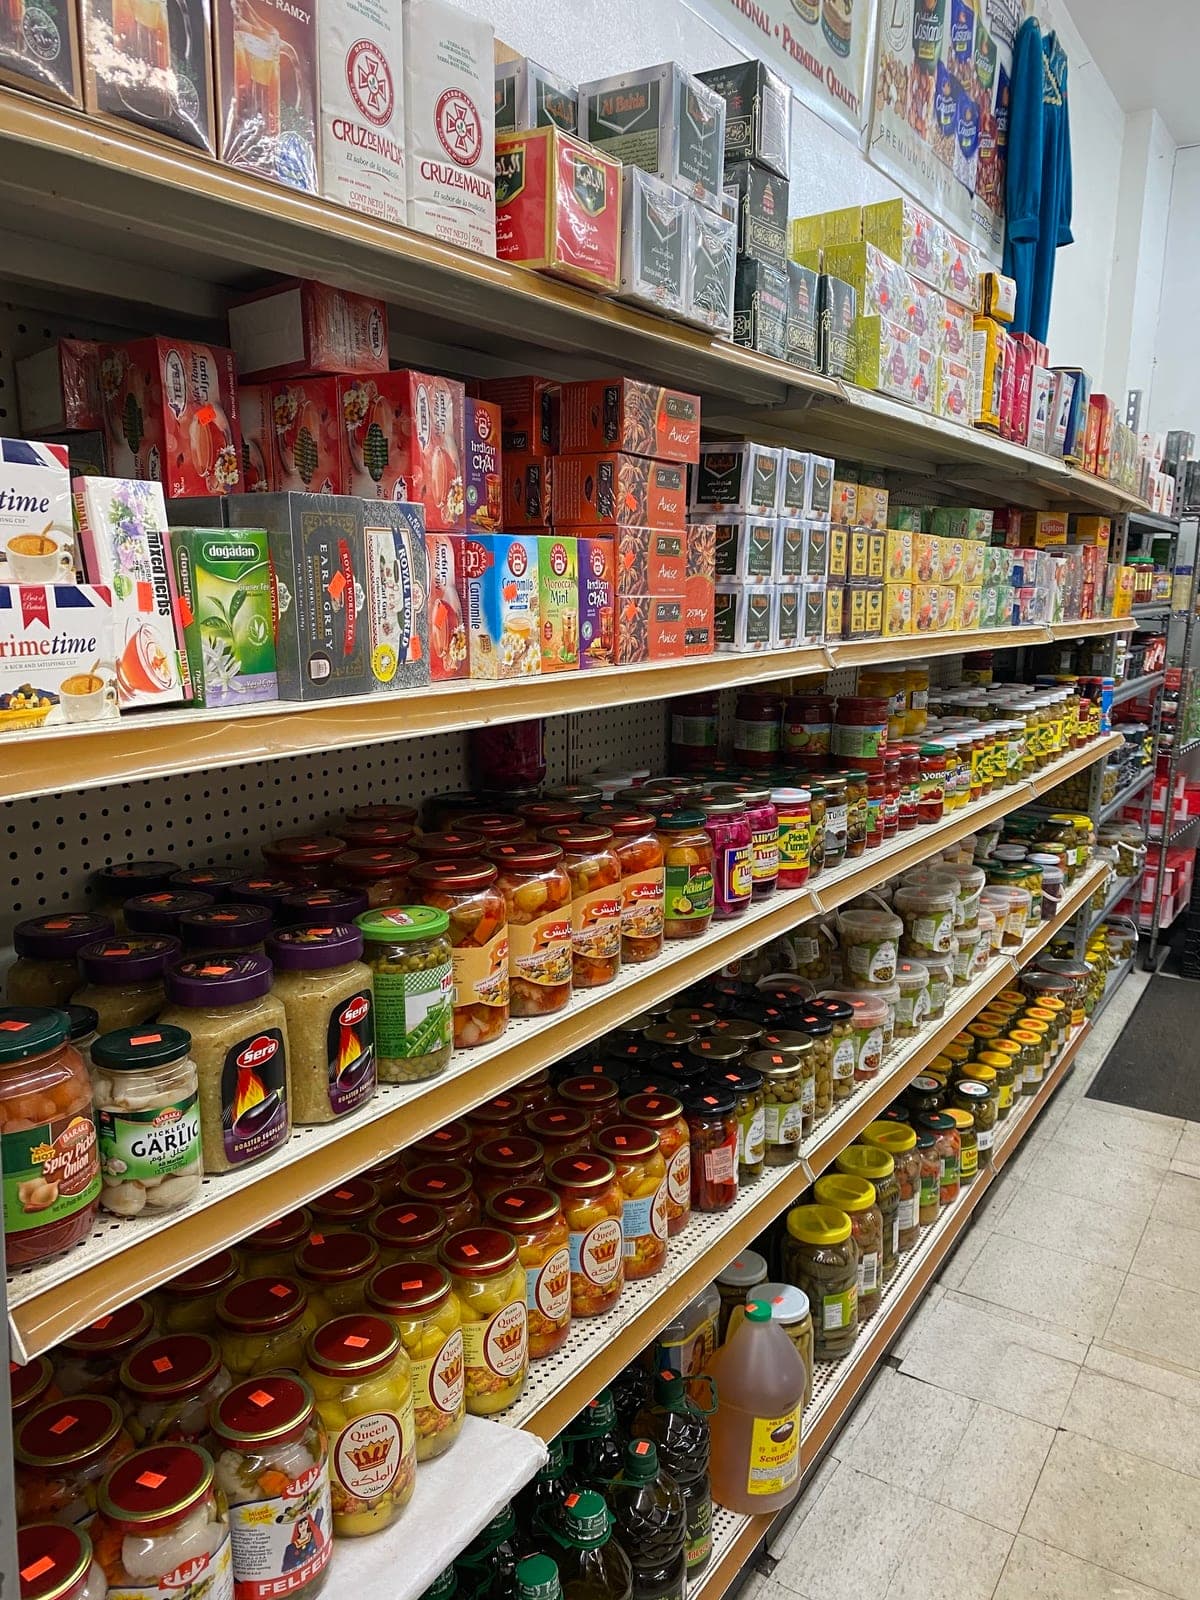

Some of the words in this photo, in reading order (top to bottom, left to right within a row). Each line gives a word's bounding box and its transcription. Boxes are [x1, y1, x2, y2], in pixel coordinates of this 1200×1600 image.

[276, 0, 311, 25] RAMZY
[782, 23, 824, 83] PREMIUM
[826, 66, 860, 115] QUALITY
[331, 118, 369, 149] CRUZ
[368, 131, 378, 147] DE
[376, 134, 405, 169] MALTA
[880, 123, 919, 167] PREMIUM
[346, 152, 353, 161] El
[353, 155, 369, 167] sabor
[420, 160, 455, 187] CRUZ
[454, 172, 464, 185] DE
[463, 173, 493, 203] MALTA
[349, 190, 368, 204] CONT
[367, 195, 385, 210] NETO
[433, 190, 440, 198] El
[440, 194, 456, 203] sabor
[435, 223, 453, 236] CONT
[453, 227, 469, 241] NETO
[170, 361, 182, 401] TEEBA
[668, 426, 692, 445] Anise
[470, 440, 496, 456] Indian
[0, 487, 50, 514] time
[657, 496, 678, 513] Anise
[75, 491, 89, 532] BARAKA
[1040, 523, 1064, 533] Lipton
[147, 531, 164, 572] mixed
[471, 542, 488, 578] TEEKANNE
[143, 560, 152, 583] HERBA
[319, 543, 332, 593] EARL
[342, 553, 353, 585] ROYAL
[397, 547, 412, 594] ROYAL
[658, 563, 679, 580] Anise
[180, 552, 193, 607] doğad
[587, 578, 609, 591] Indian
[152, 571, 171, 616] herbs
[346, 586, 354, 621] WORLD
[550, 589, 569, 606] Mint
[380, 600, 389, 621] Grey
[469, 581, 482, 630] Camomile
[322, 600, 334, 650] GREY
[346, 624, 354, 642] TEA
[401, 597, 412, 648] WORLD
[0, 631, 97, 658] rimetime
[658, 629, 679, 644] Anise
[178, 650, 191, 687] BARAKA
[683, 881, 702, 896] Pickled
[343, 1002, 370, 1023] Sera
[243, 1043, 276, 1065] Sera
[154, 1110, 181, 1124] BARAKA
[62, 1123, 89, 1143] BARAKA
[131, 1119, 199, 1158] GARLIC
[147, 1122, 186, 1139] PICKLED
[234, 1137, 261, 1153] ROASTED
[33, 1150, 55, 1163] HOT
[42, 1149, 75, 1175] Spicy
[63, 1152, 90, 1180] Onion
[592, 1227, 618, 1243] Queen
[591, 1259, 619, 1278] الملكة
[497, 1310, 523, 1329] Queen
[350, 1424, 389, 1443] Queen
[360, 1420, 380, 1430] Pickles
[759, 1452, 788, 1464] Sesame
[350, 1463, 394, 1487] الملكة
[248, 1508, 269, 1518] Mixed
[248, 1514, 273, 1523] Pickles
[259, 1537, 334, 1597] FELFEL
